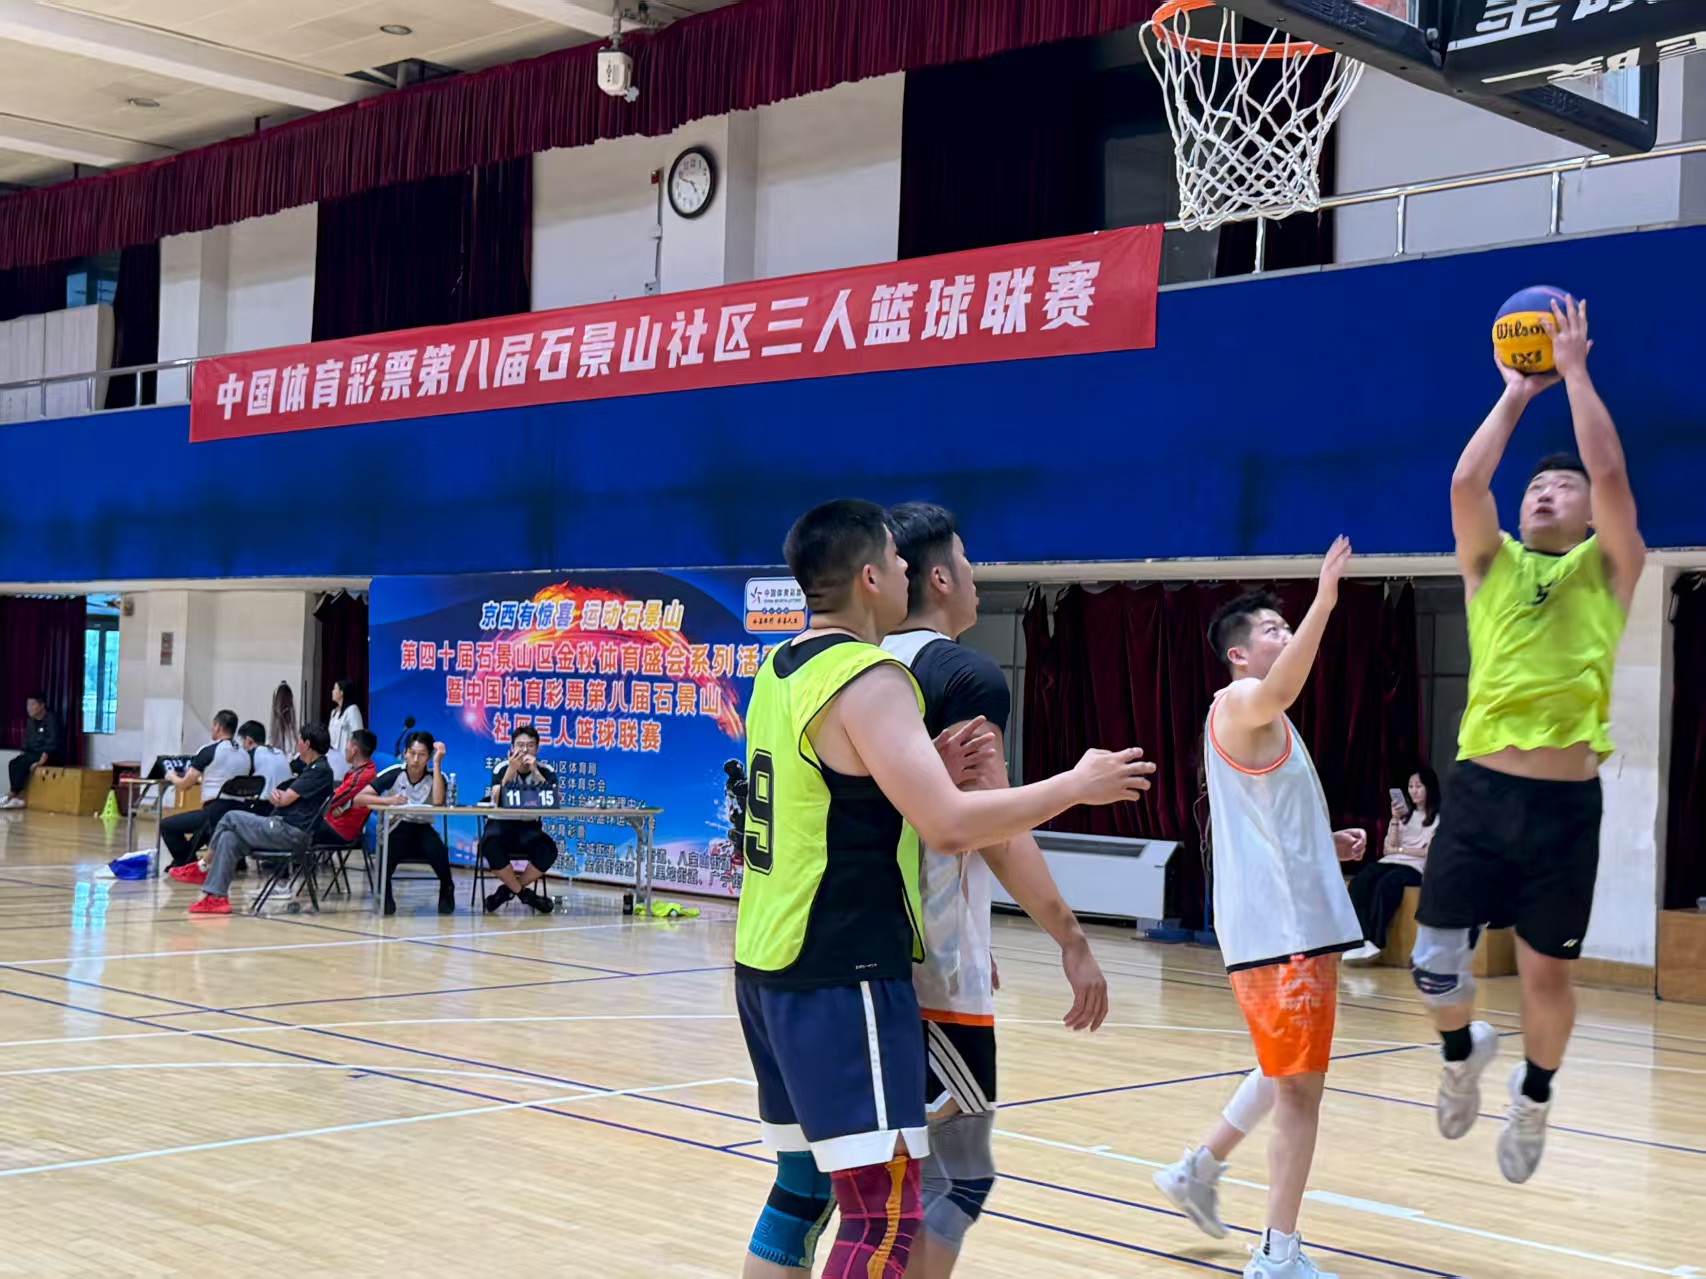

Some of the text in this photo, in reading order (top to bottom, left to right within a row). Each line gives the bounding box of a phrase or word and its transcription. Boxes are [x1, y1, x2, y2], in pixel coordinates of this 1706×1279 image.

[216, 260, 1100, 420] 中国体育彩票第八届石景山社区三人篮球联赛
[479, 599, 684, 631] 京西有惊喜 运动石景山
[446, 675, 721, 716] 暨中国体育彩票第八届石景山
[506, 790, 521, 806] 11
[538, 790, 554, 806] 15
[744, 748, 774, 876] 9
